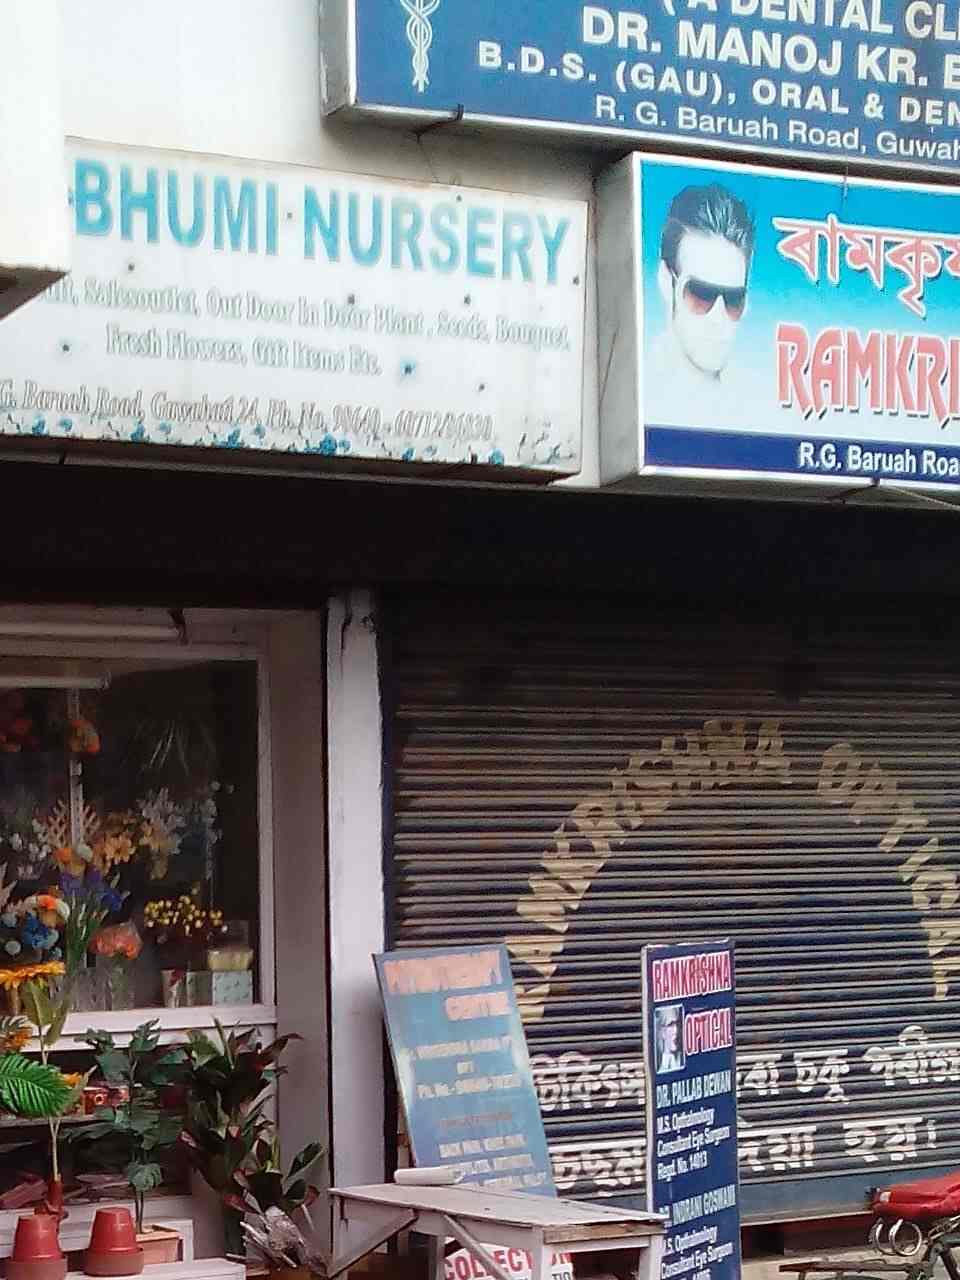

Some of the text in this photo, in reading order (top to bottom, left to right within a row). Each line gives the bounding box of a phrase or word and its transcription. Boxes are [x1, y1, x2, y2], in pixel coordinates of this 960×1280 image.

[583, 6, 661, 53] DR.
[678, 20, 841, 76] MANOJ
[857, 43, 928, 87] KR.
[478, 40, 596, 82] B.D.S.
[615, 60, 736, 105] (GAU),
[752, 78, 849, 114] ORAL
[863, 92, 884, 119] &
[596, 95, 624, 121] R.
[635, 101, 666, 126] G.
[677, 106, 778, 140] Baruah
[789, 120, 866, 153] Road,
[75, 159, 570, 286] BHUMI NURSERY
[798, 440, 841, 469] R.G.
[847, 444, 916, 473] Baruah
[653, 951, 731, 1002] RAMKRISHNA
[685, 1008, 732, 1056] OPTICAL
